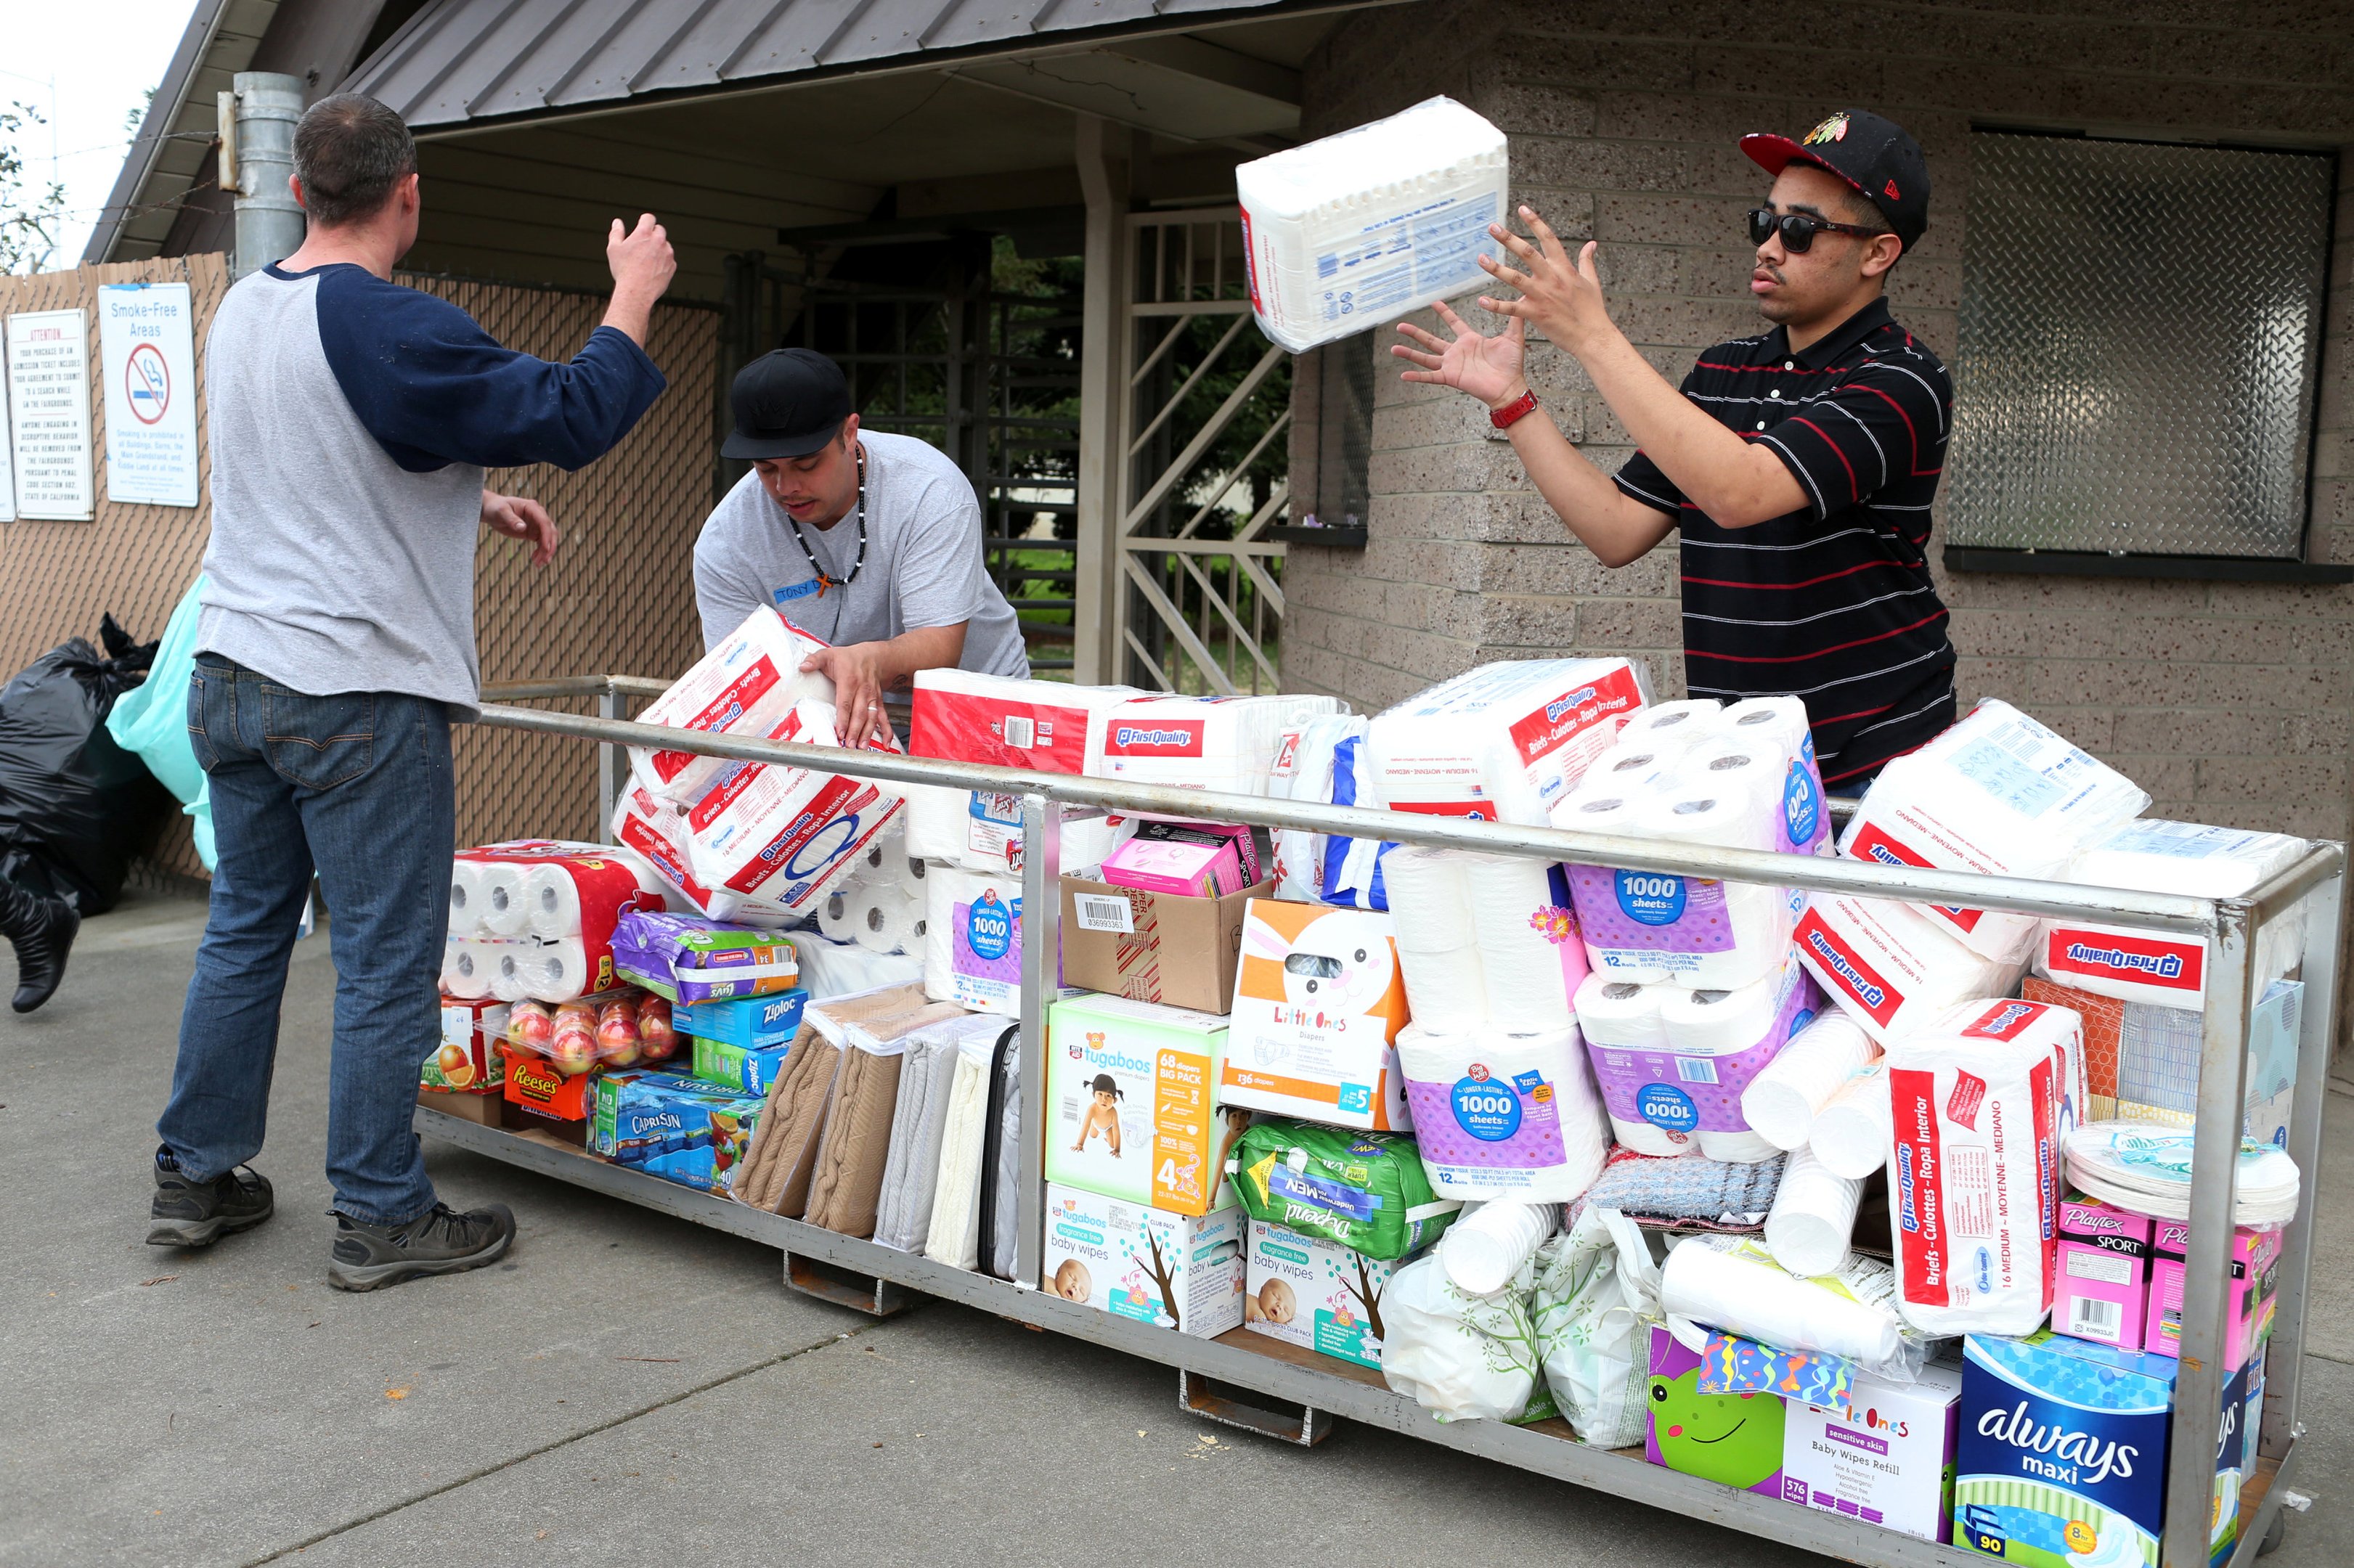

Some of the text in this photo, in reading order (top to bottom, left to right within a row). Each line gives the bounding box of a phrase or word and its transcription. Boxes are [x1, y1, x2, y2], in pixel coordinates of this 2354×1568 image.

[111, 303, 177, 317] Smoke-Free
[30, 328, 60, 341] ATTENTION
[130, 324, 160, 338] Areas
[777, 586, 808, 599] TONY
[741, 667, 760, 688] Briefs
[711, 689, 738, 716] Culottes
[1528, 695, 1628, 756] Briefs Culottes Ropa Interior
[703, 773, 749, 823] Briefs Culottes
[730, 828, 752, 851] MEDIUM
[746, 868, 768, 889] Briefs
[771, 836, 801, 867] Culottes
[803, 816, 823, 836] Ropa
[821, 790, 850, 817] Interior
[1895, 809, 1964, 859] MOYENNE MEDIANO
[1240, 831, 1257, 870] Playtex
[1239, 860, 1252, 888] SPORT
[1624, 877, 1676, 898] 1000
[1632, 899, 1666, 909] sheets
[1790, 897, 1801, 912] 12
[974, 917, 1006, 937] 1000
[1088, 919, 1123, 928] 036993363
[977, 936, 1001, 946] sheets
[1836, 900, 1915, 978] MEDIUM MOYENNE MEDIANO
[760, 955, 769, 963] 34
[1604, 957, 1621, 967] 12
[764, 998, 795, 1024] Ziploc
[1274, 1007, 1346, 1032] Little Ones
[1300, 1032, 1324, 1042] Diapers
[1084, 1046, 1150, 1074] tugaboos
[1160, 1054, 1200, 1073] 68 diapers
[749, 1058, 759, 1090] Ziploc
[1160, 1069, 1202, 1085] BIG PACK
[1237, 1074, 1274, 1086] 136 diapers
[1473, 1071, 1488, 1080] Win
[602, 1093, 612, 1105] NO
[1356, 1089, 1367, 1108] 5
[1463, 1086, 1503, 1095] LONGER-LASTING
[1458, 1096, 1511, 1114] 1000
[1645, 1102, 1691, 1119] 1000
[1469, 1114, 1502, 1124] sheets
[720, 1170, 731, 1185] 40
[1157, 1158, 1177, 1191] 4
[1439, 1173, 1453, 1184] 12
[1285, 1177, 1355, 1211] Underwear MEN
[1914, 1095, 1940, 1286] Briefs Culottes Ropa Interior
[1991, 1101, 2011, 1274] MEDIUM MOYENNE MEDIANO
[1062, 1209, 1107, 1228] tugaboos
[1284, 1202, 1351, 1238] Depend
[2064, 1208, 2124, 1233] Playtex
[1059, 1225, 1101, 1243] fragrance free
[1196, 1222, 1225, 1241] tugaboos
[1266, 1227, 1311, 1249] tugaboos
[1051, 1233, 1109, 1261] baby wipes
[1262, 1244, 1307, 1262] fragrance free
[2097, 1236, 2139, 1254] SPORT
[1189, 1262, 1205, 1276] baby
[1254, 1252, 1314, 1281] baby wipes
[1867, 1408, 1908, 1437] Ones
[1830, 1429, 1884, 1452] sensitive skin
[1978, 1400, 2138, 1485] always
[1812, 1441, 1899, 1476] Baby Wipes Refill
[1852, 1468, 1870, 1479] Vitamin
[2022, 1455, 2077, 1485] maxi
[1786, 1479, 1805, 1495] 576
[1836, 1472, 1873, 1489] Hypoallergenic
[1839, 1482, 1858, 1492] Alcohol
[1786, 1490, 1804, 1502] wipes
[1836, 1489, 1860, 1501] Fragrance
[1980, 1535, 2001, 1553] 90
